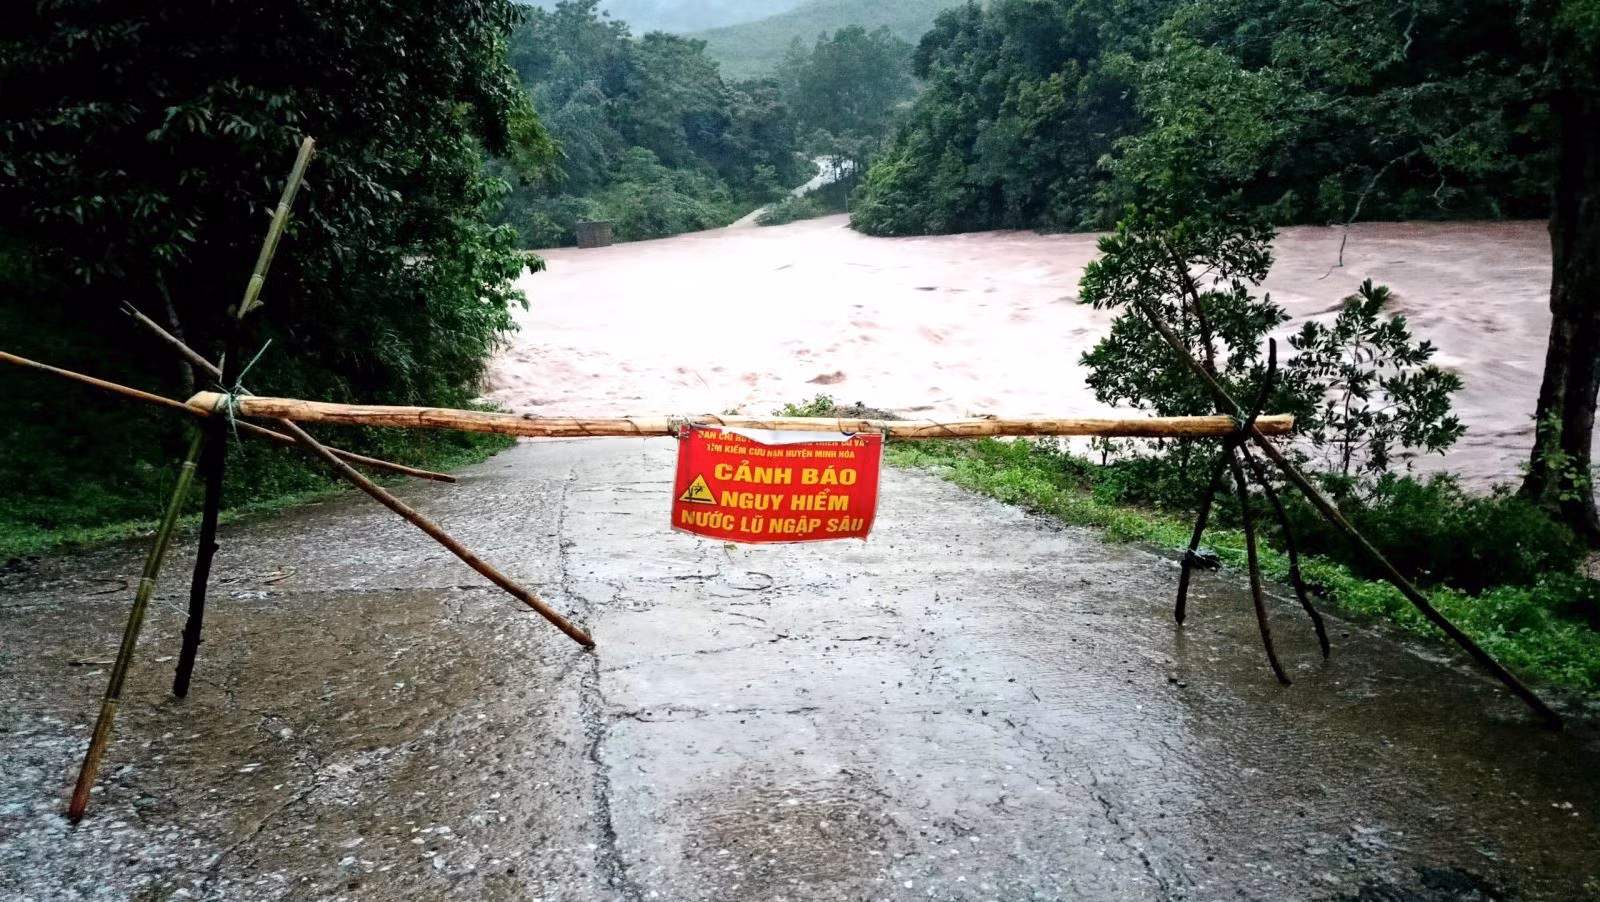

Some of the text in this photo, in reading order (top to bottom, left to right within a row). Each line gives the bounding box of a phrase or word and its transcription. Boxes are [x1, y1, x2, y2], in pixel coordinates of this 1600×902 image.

[785, 448, 813, 459] HUYỆN
[814, 450, 837, 458] MINH
[714, 459, 857, 486] CẢNH BÁO
[720, 487, 849, 511] NGUY HIỂM
[681, 509, 864, 537] NƯỚC LŨ NGẬP SÂU
